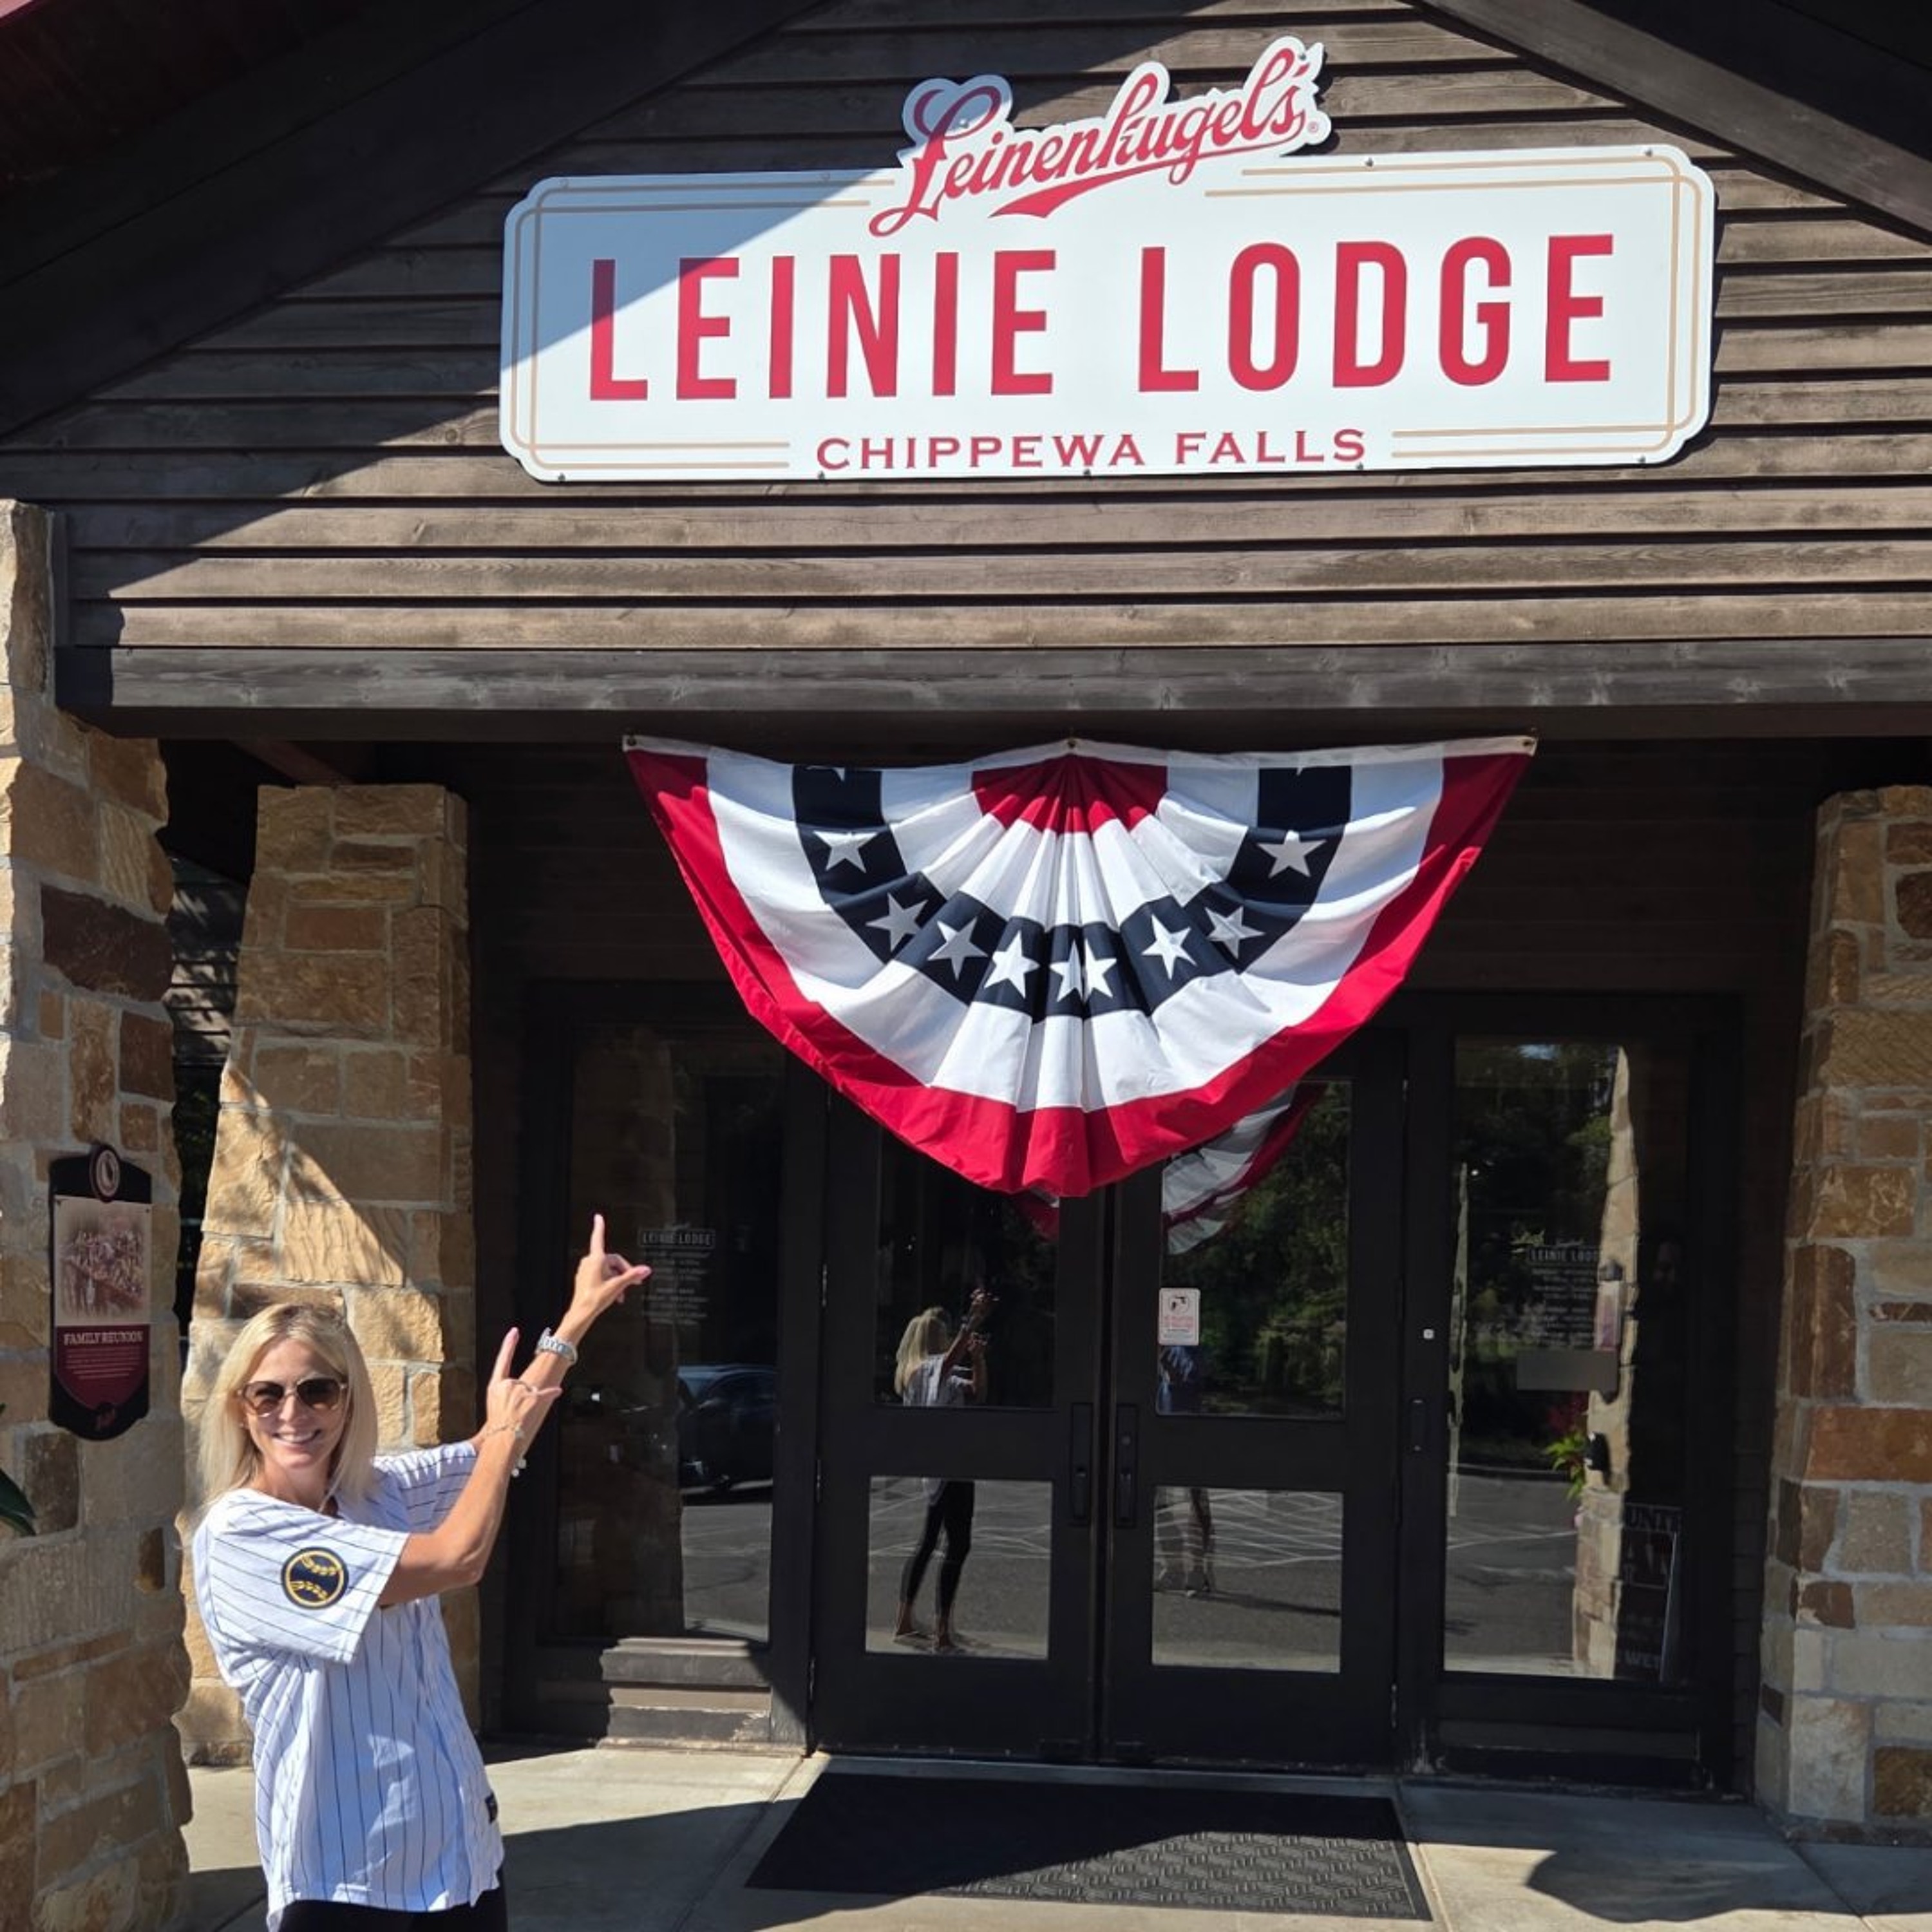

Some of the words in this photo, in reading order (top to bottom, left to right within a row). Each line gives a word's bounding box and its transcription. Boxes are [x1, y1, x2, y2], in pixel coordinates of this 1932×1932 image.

[869, 48, 1308, 237] Leinenkugel's
[590, 249, 1057, 401] LEINIE
[1138, 232, 1614, 393] LODGE
[816, 433, 1145, 470] CHIPPEWA
[1175, 428, 1366, 465] FALLS
